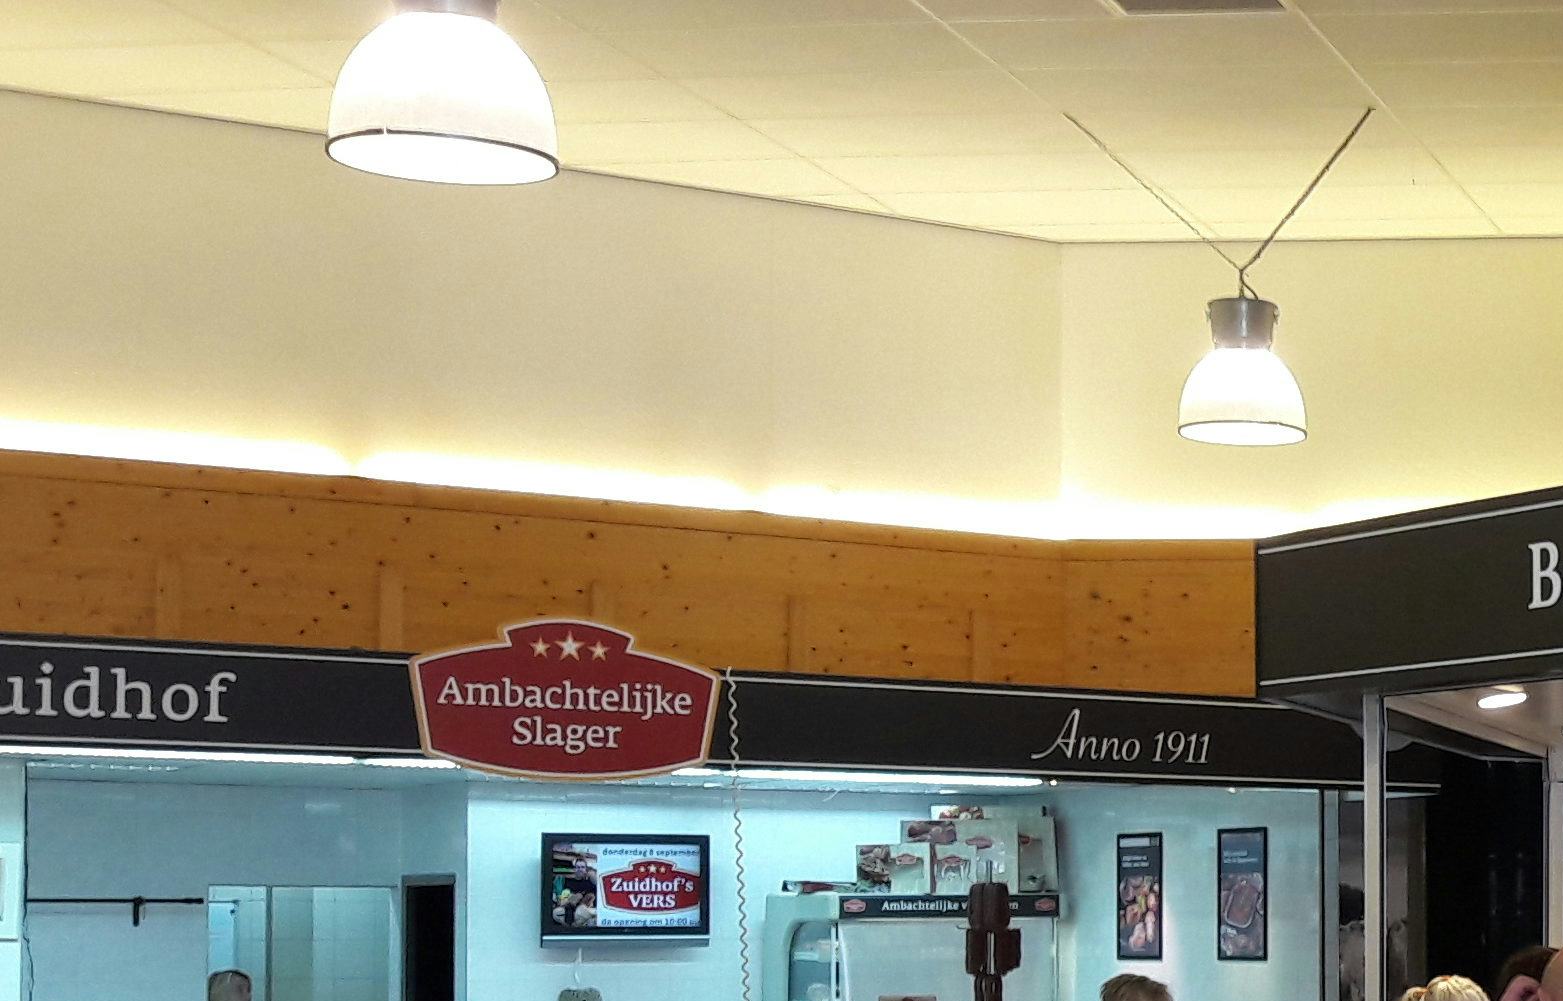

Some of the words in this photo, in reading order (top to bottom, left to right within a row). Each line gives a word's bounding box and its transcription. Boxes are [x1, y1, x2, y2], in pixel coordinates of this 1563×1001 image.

[0, 661, 237, 723] uidhof
[436, 675, 693, 721] Ambachtelijke
[511, 715, 622, 754] Slager
[1030, 707, 1141, 762] Anno
[1151, 730, 1210, 764] 1911
[610, 876, 694, 892] Zuidhof's
[628, 893, 676, 908] VERS
[881, 900, 960, 913] Ambachtelijke
